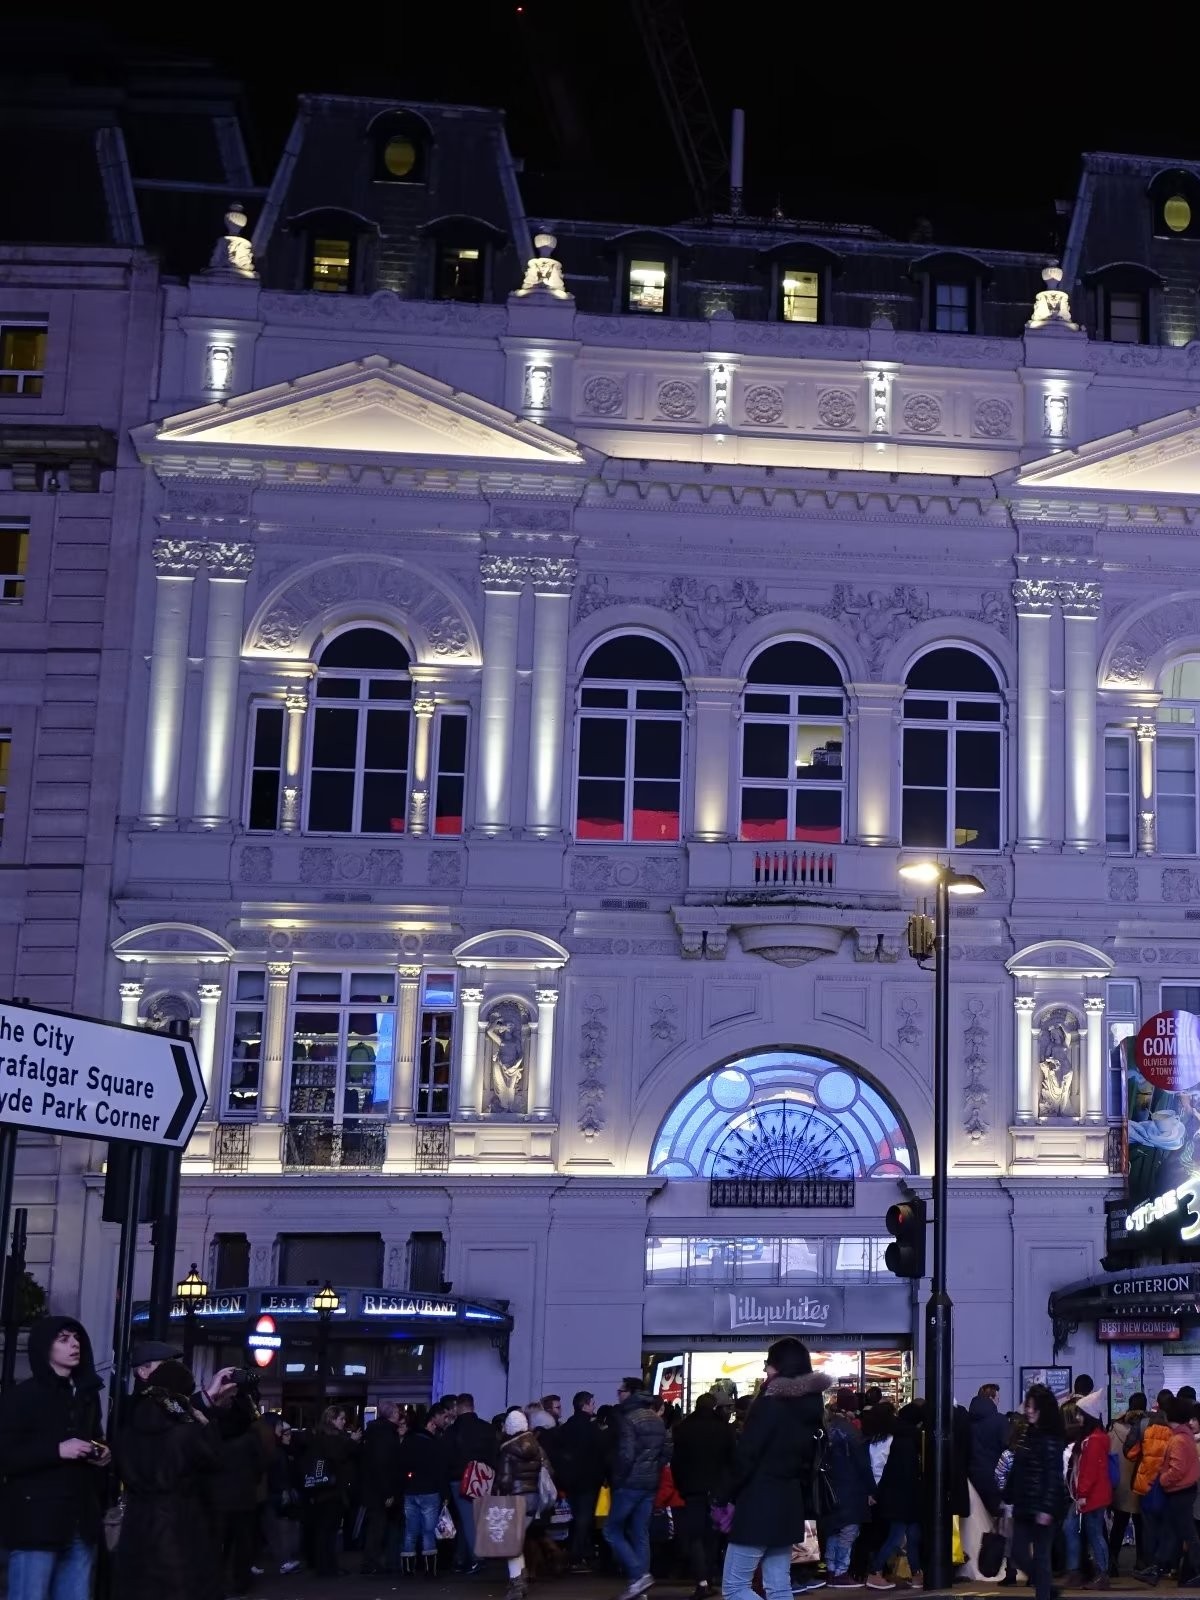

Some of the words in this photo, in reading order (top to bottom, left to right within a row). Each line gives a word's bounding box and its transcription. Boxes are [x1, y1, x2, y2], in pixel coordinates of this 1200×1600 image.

[0, 1016, 24, 1042] he
[34, 1022, 74, 1056] City
[0, 1054, 78, 1087] rafalgar
[87, 1066, 154, 1099] Square
[0, 1088, 33, 1114] yde
[42, 1092, 88, 1121] Park
[95, 1101, 160, 1132] Corner
[1113, 1275, 1190, 1295] CRITERION
[268, 1296, 300, 1309] EST.
[363, 1295, 457, 1313] RESTAURANT
[728, 1292, 830, 1329] Lillywhites
[931, 1316, 937, 1325] 5
[1101, 1322, 1122, 1333] BEST
[1123, 1322, 1142, 1333] NEW
[1143, 1322, 1177, 1333] COMEDY
